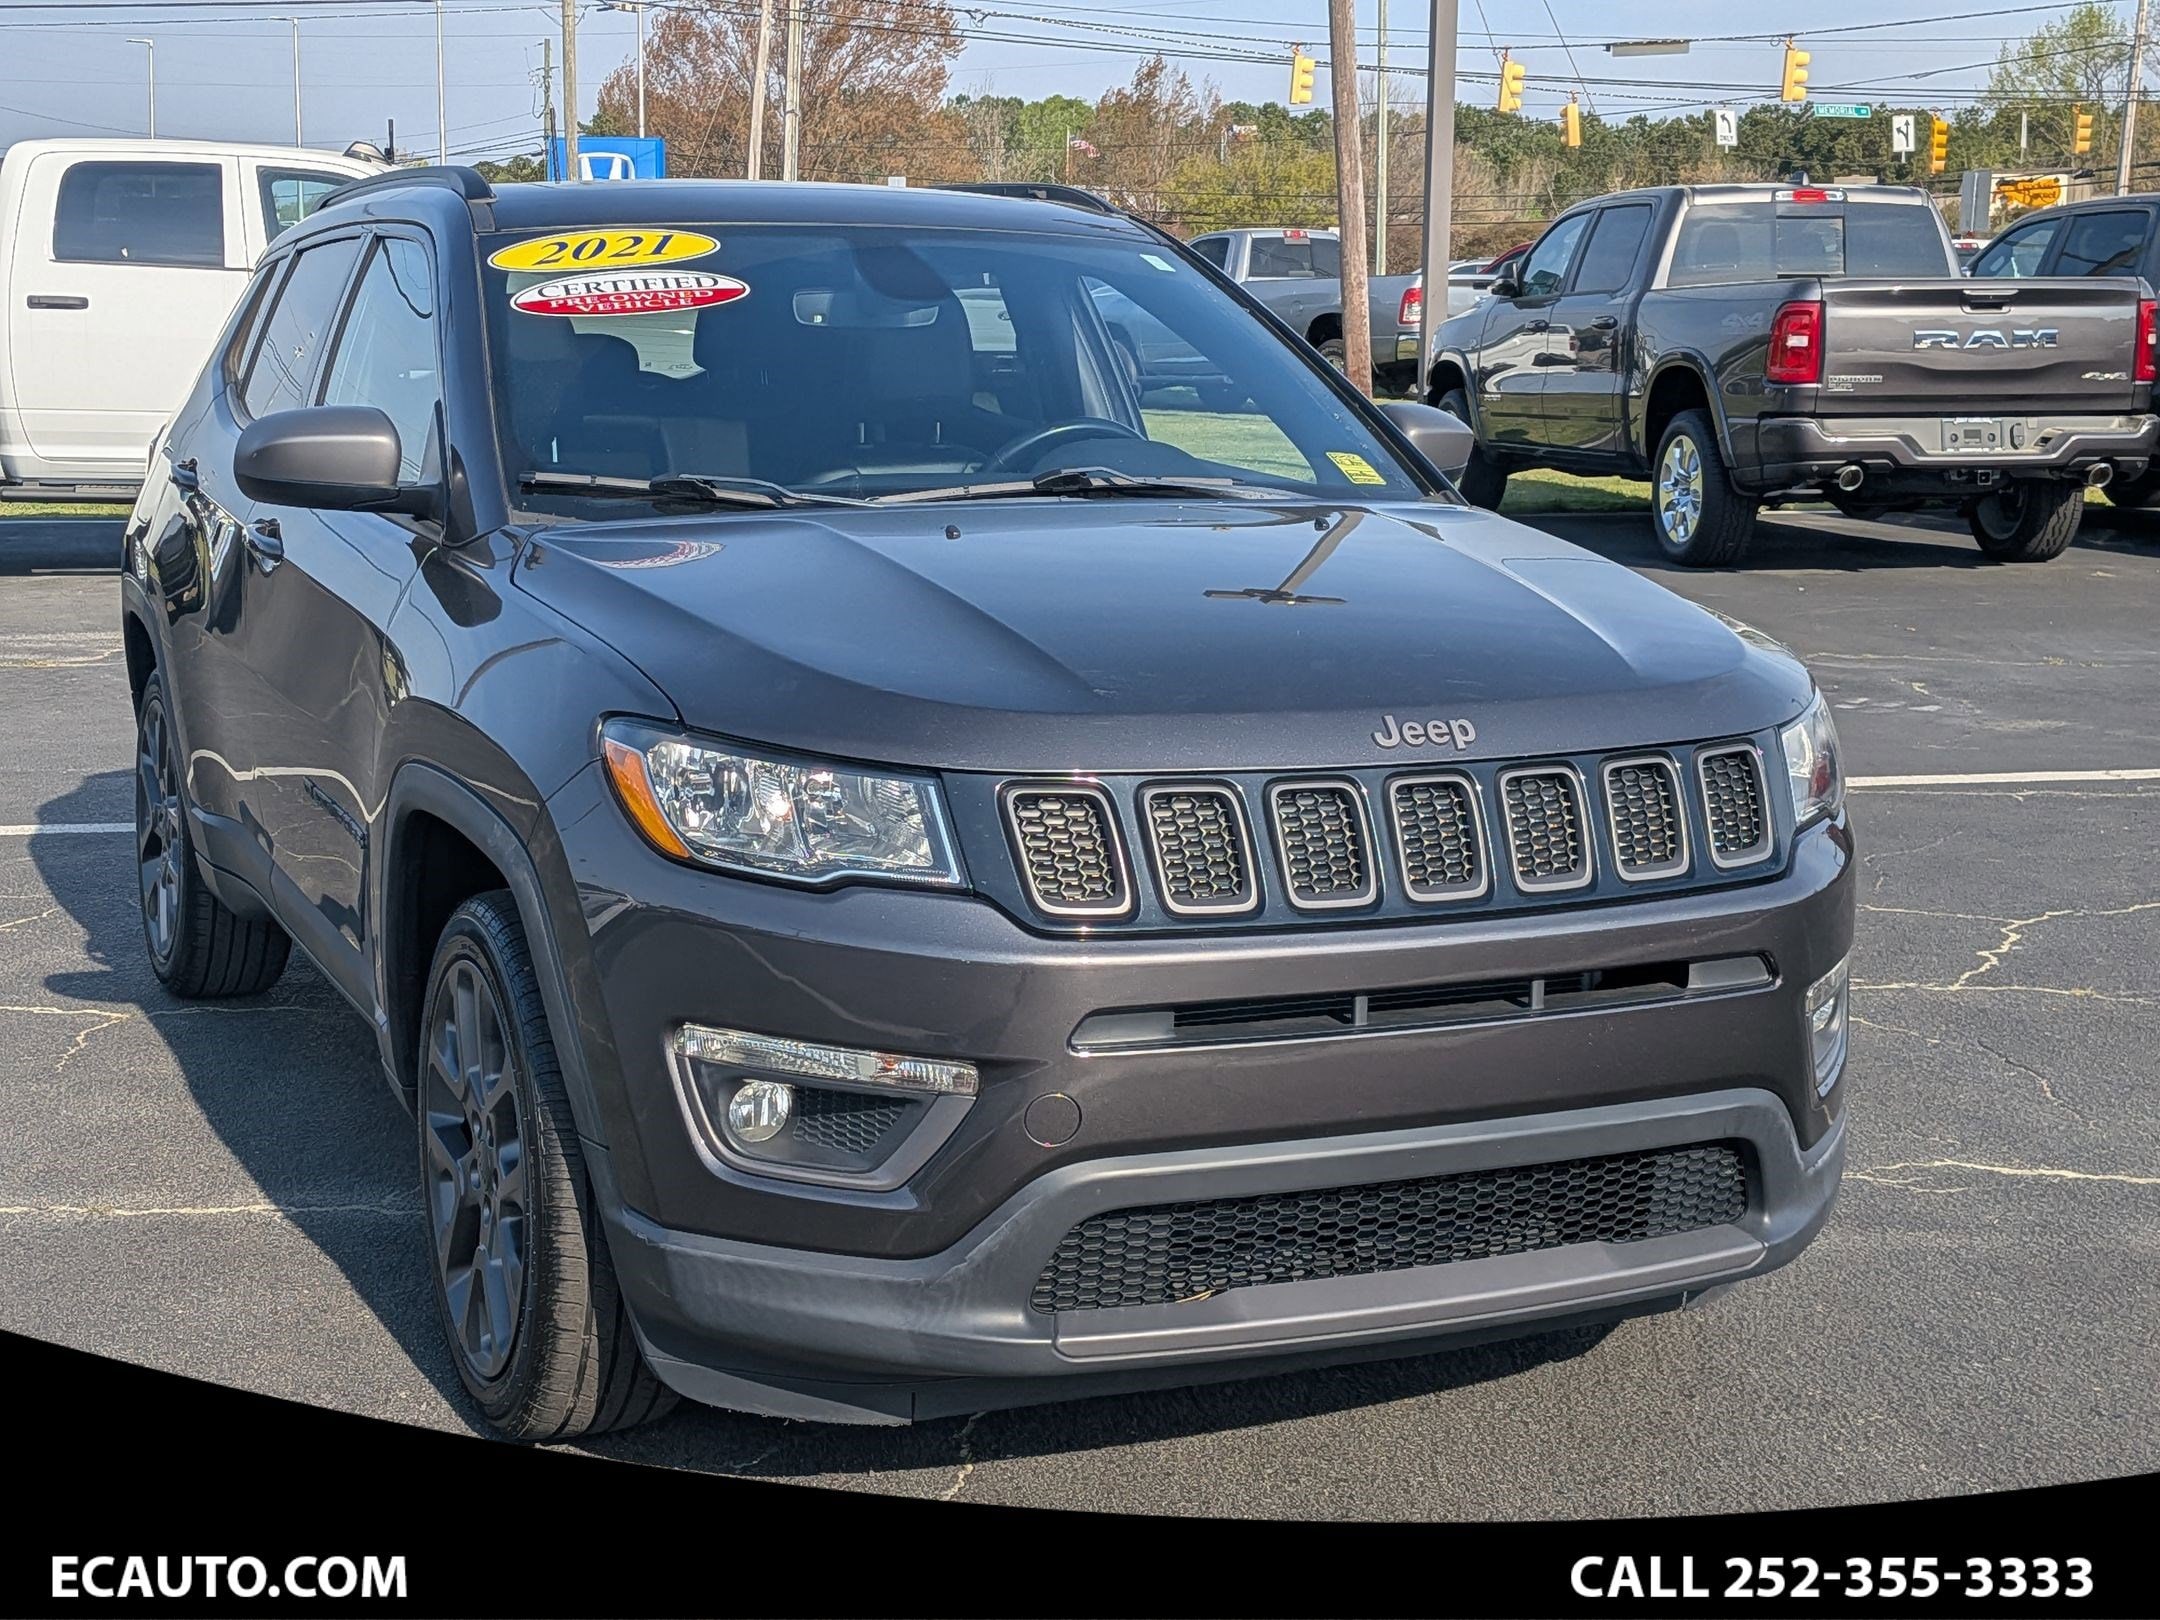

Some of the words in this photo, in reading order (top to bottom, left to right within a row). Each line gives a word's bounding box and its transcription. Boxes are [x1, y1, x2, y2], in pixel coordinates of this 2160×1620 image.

[1816, 105, 1855, 115] MEMORIAL
[531, 234, 674, 266] 2021
[537, 276, 719, 298] CERTIFIED
[550, 289, 714, 308] PRE-OWNED
[576, 297, 694, 312] VEHICLE
[1913, 329, 2059, 349] RAM
[1372, 715, 1477, 750] Jeep
